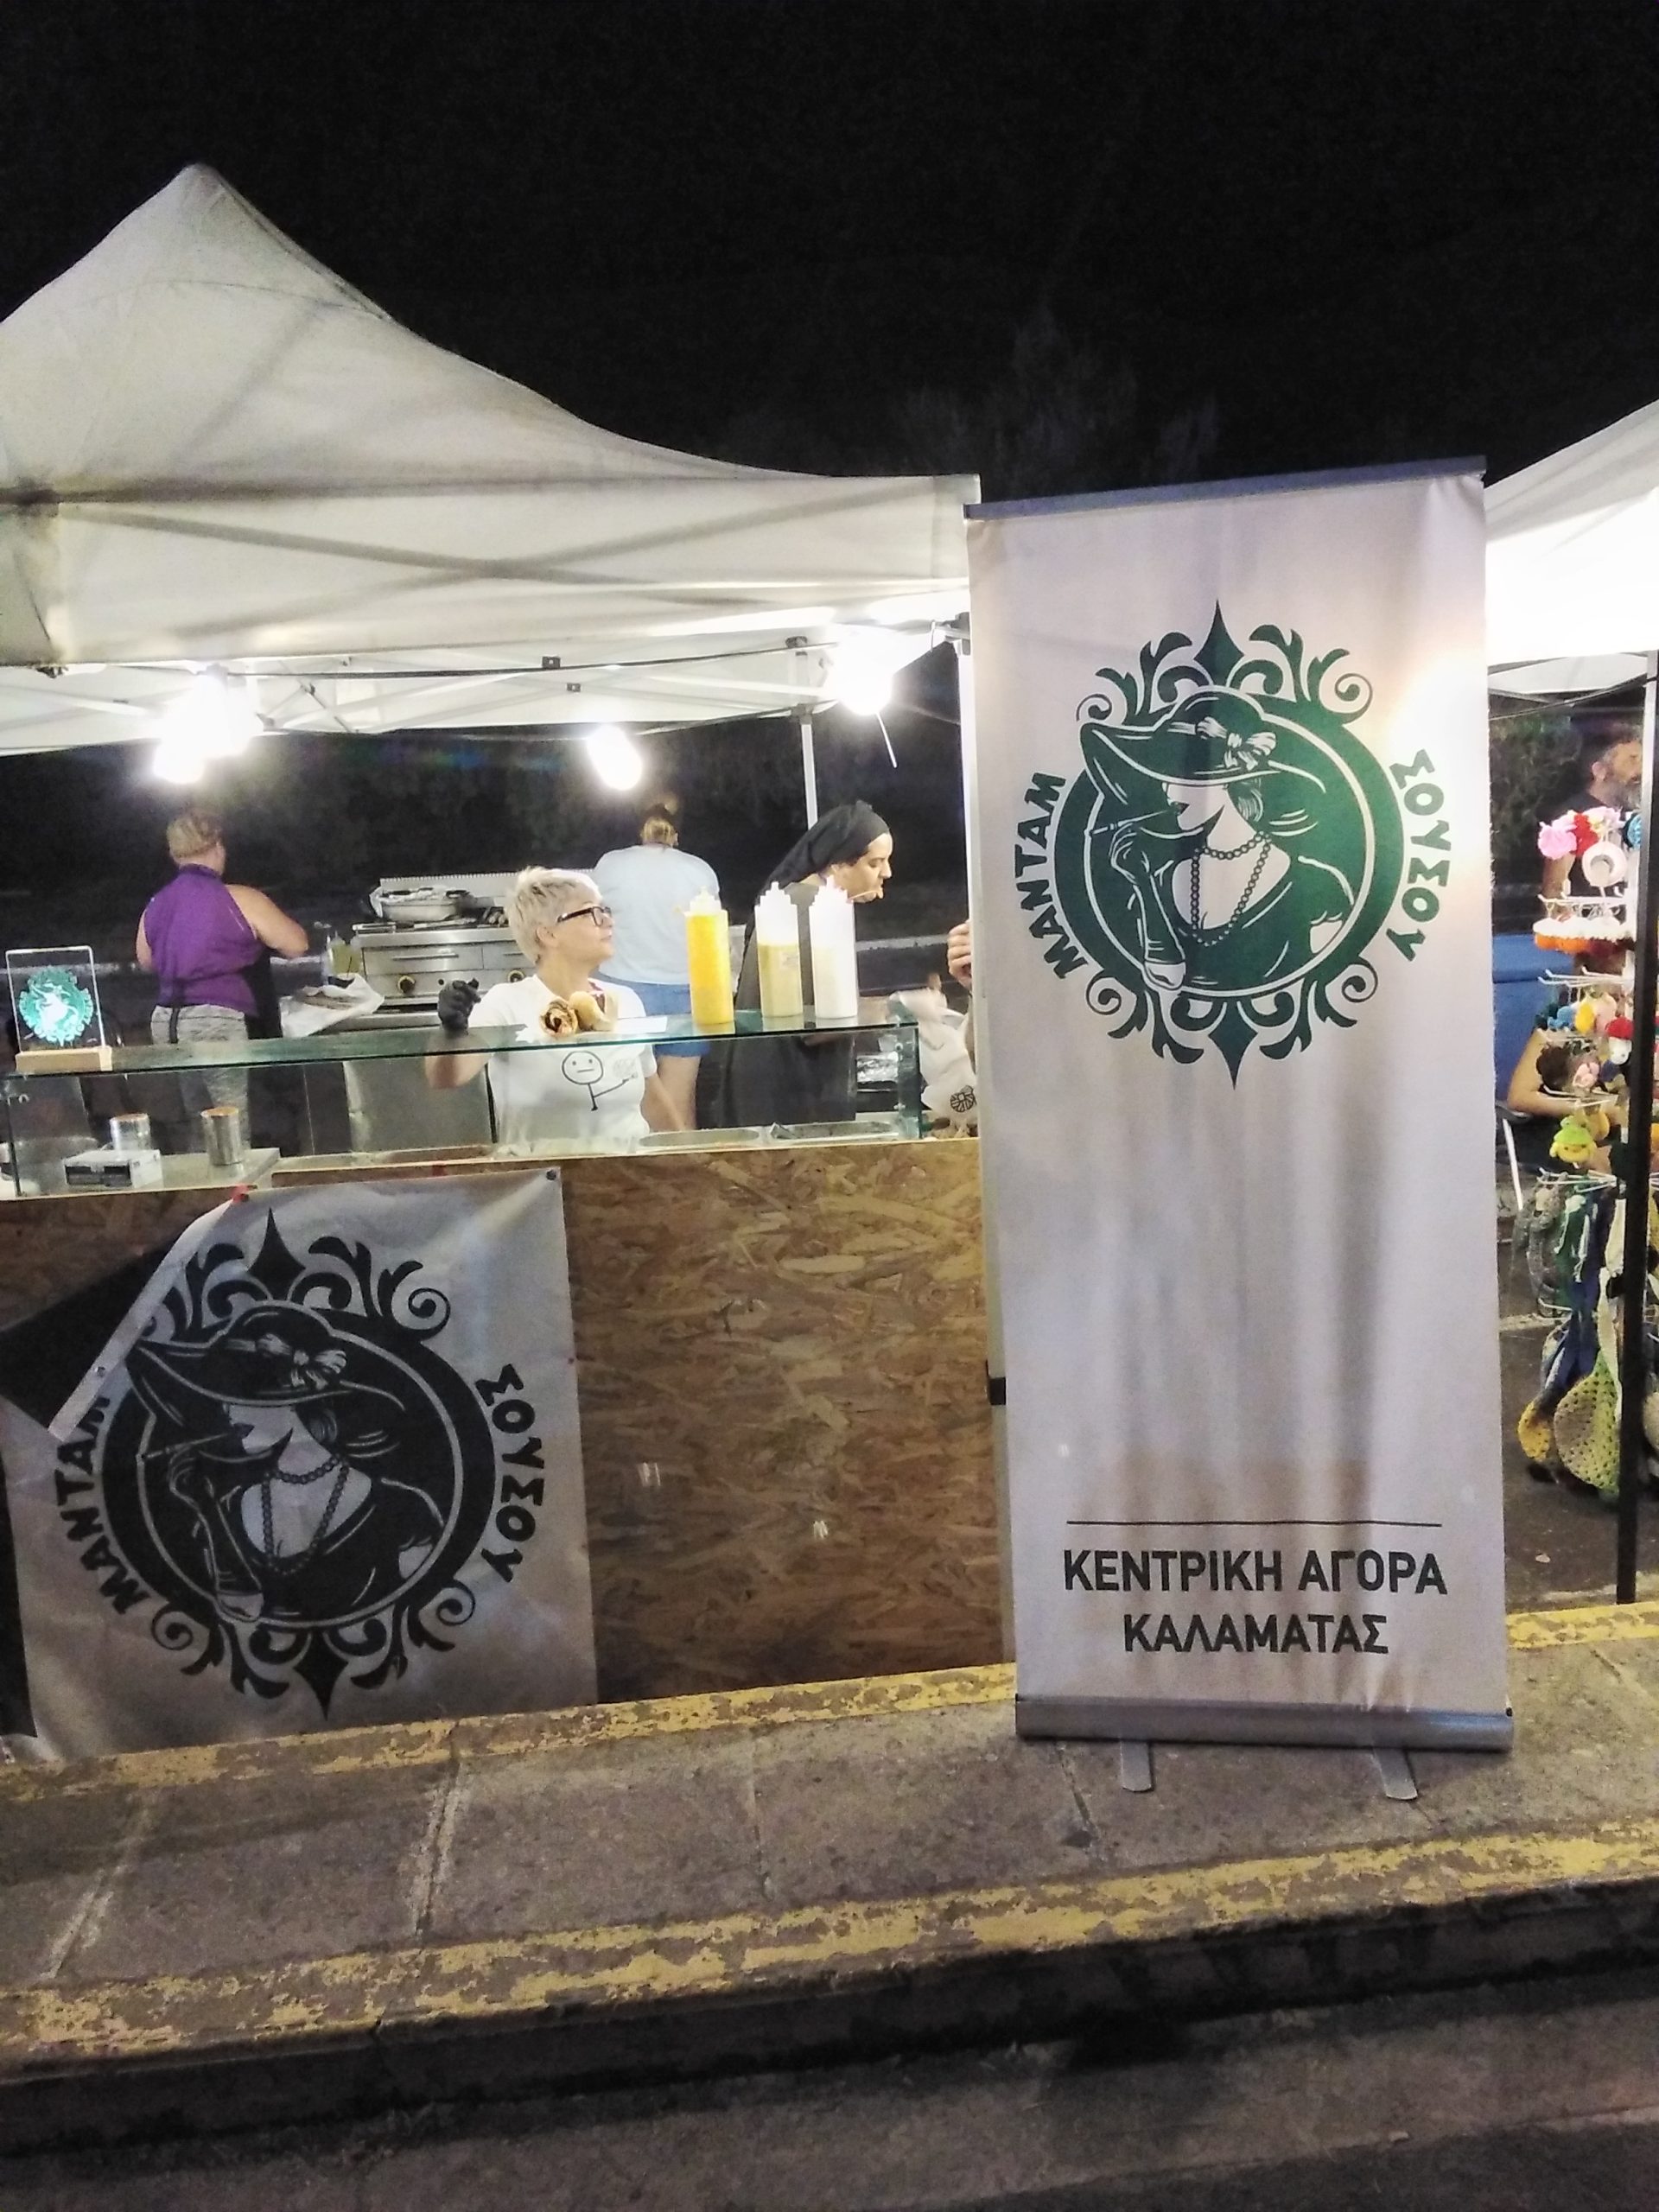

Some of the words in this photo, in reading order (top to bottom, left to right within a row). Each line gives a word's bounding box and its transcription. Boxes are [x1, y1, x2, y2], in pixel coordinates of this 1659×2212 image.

[1014, 772, 1090, 979] ΜΑΝΤΑΜ
[1388, 748, 1452, 962] ΣΟΥΣΟΥ
[477, 1363, 545, 1582] ΣΟΥΣΟΥ
[1064, 1550, 1283, 1592] ΚΕΝΤΡΙΚΗ
[1298, 1550, 1447, 1595] ΑΓΟΡΑ
[1123, 1613, 1389, 1655] ΚΑΛΑΜΑΤΑΣ
